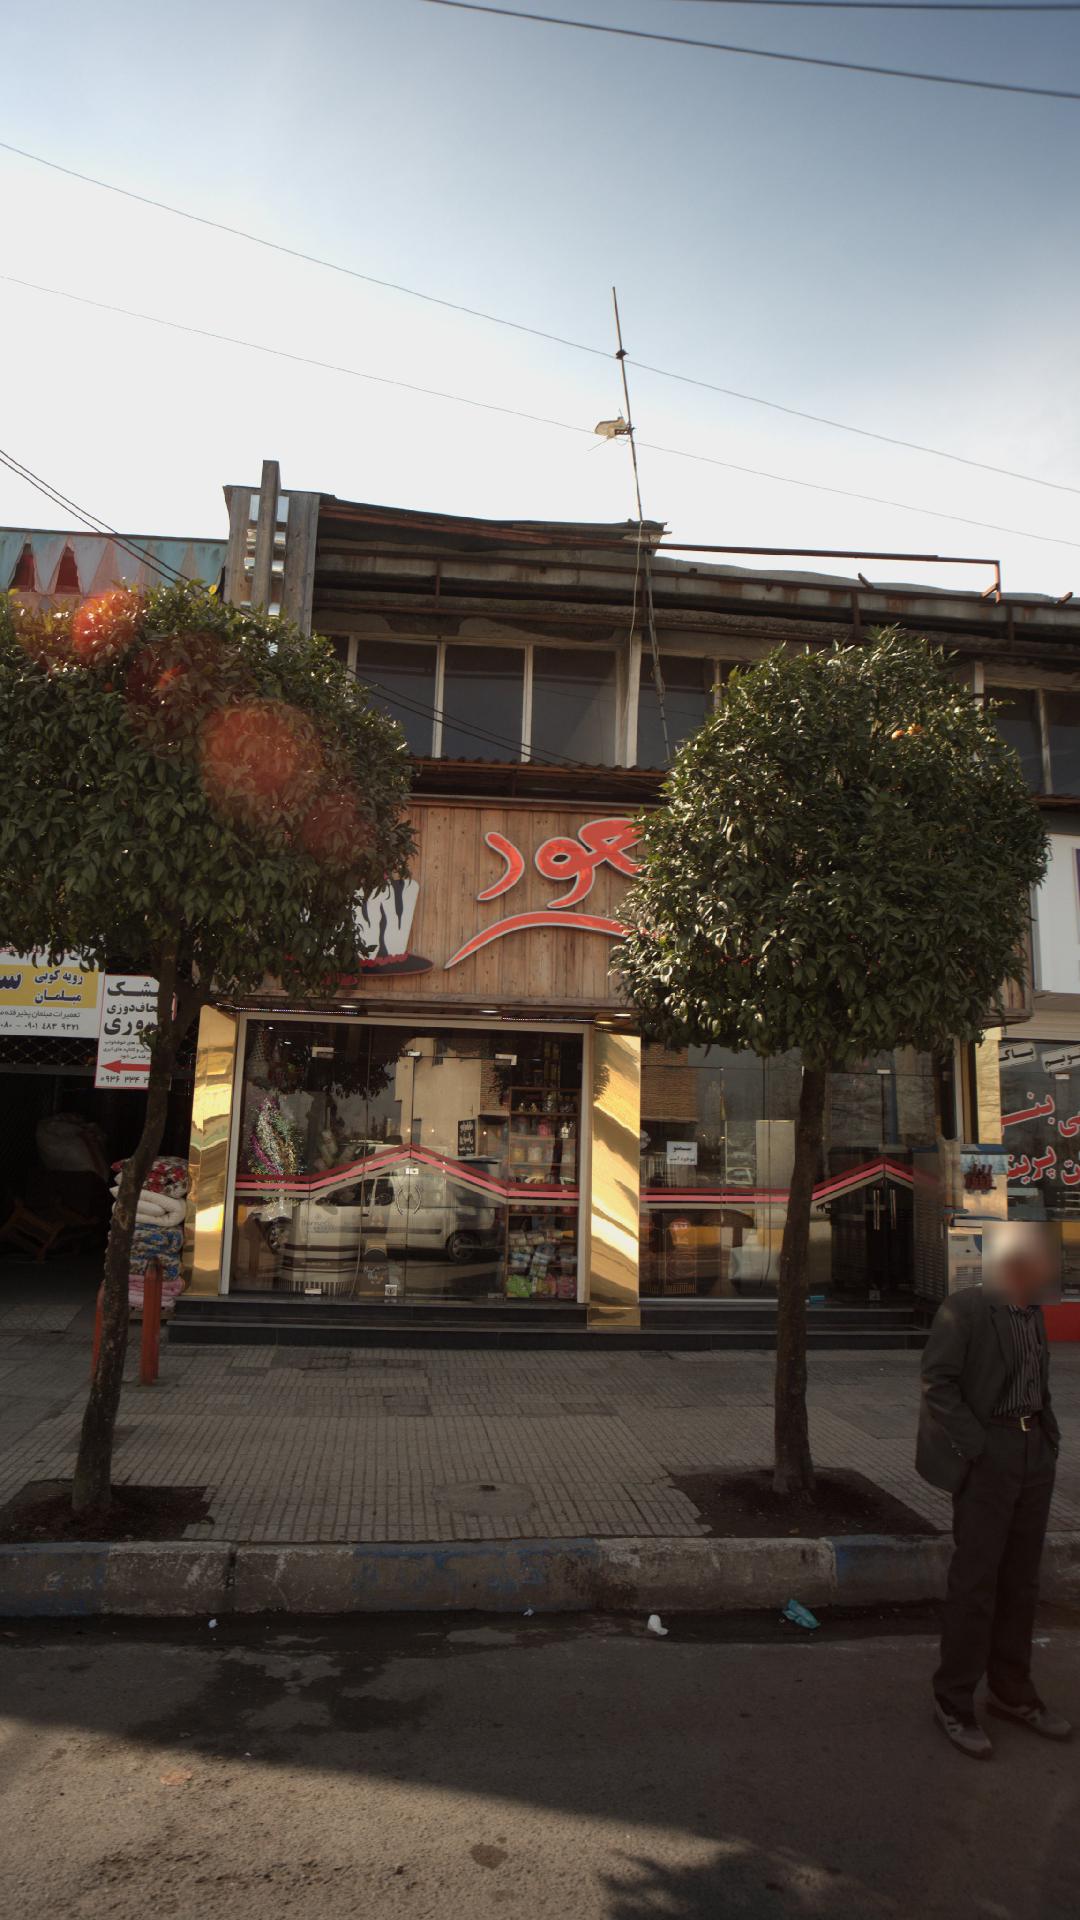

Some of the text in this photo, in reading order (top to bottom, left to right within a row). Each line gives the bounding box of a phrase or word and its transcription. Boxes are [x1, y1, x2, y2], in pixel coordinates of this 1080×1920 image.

[35, 969, 84, 985] رویه کوبی
[34, 989, 82, 1005] مبلمان
[107, 981, 160, 997] شک
[1007, 1146, 1057, 1185] پرین
